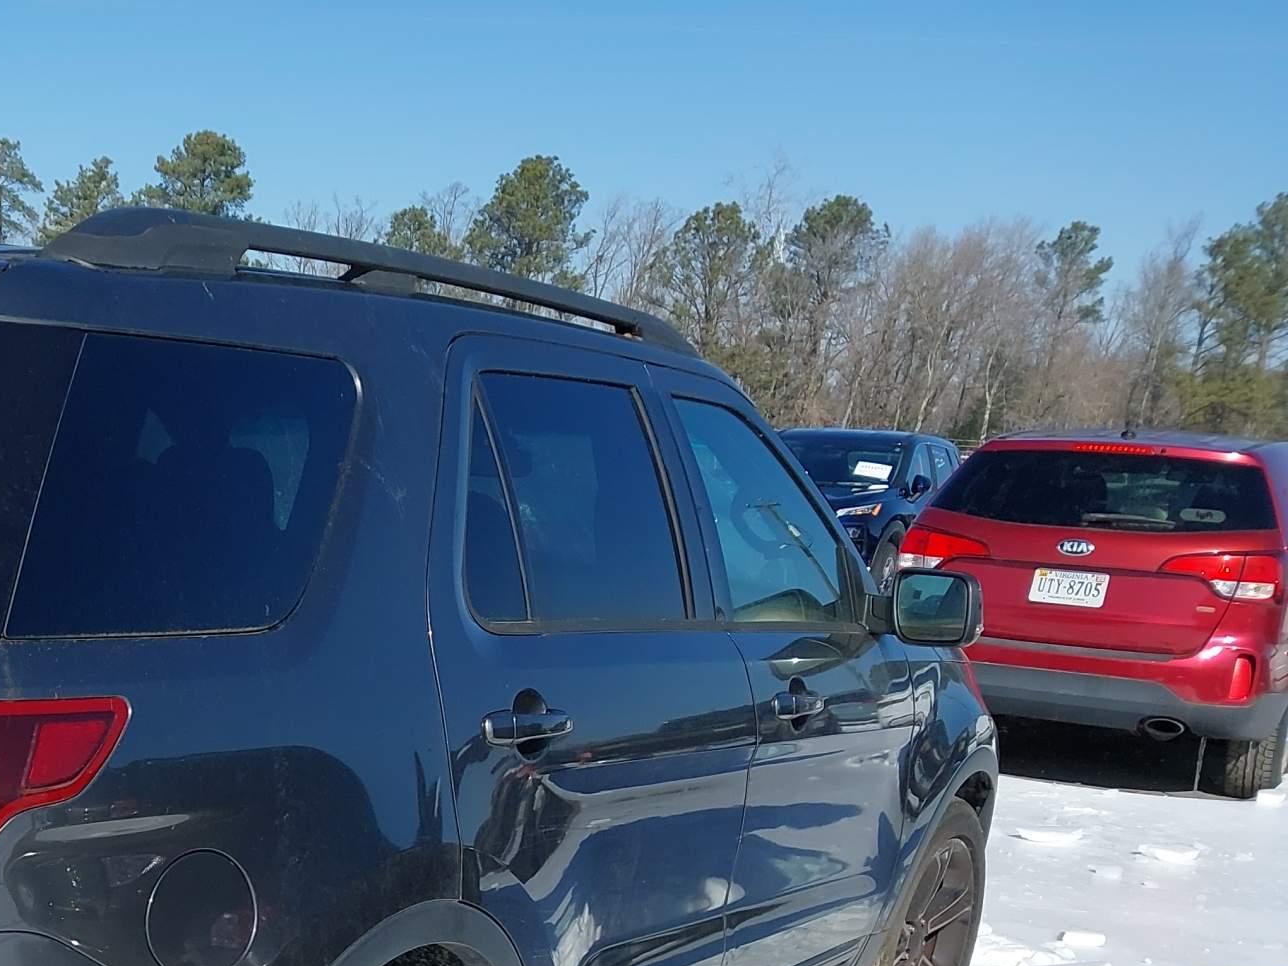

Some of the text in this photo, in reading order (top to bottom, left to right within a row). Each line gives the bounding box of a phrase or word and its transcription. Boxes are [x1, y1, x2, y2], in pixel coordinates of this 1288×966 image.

[1062, 541, 1089, 553] KIA
[1054, 572, 1090, 582] VIRGINIA
[1037, 577, 1102, 599] UTY-8705
